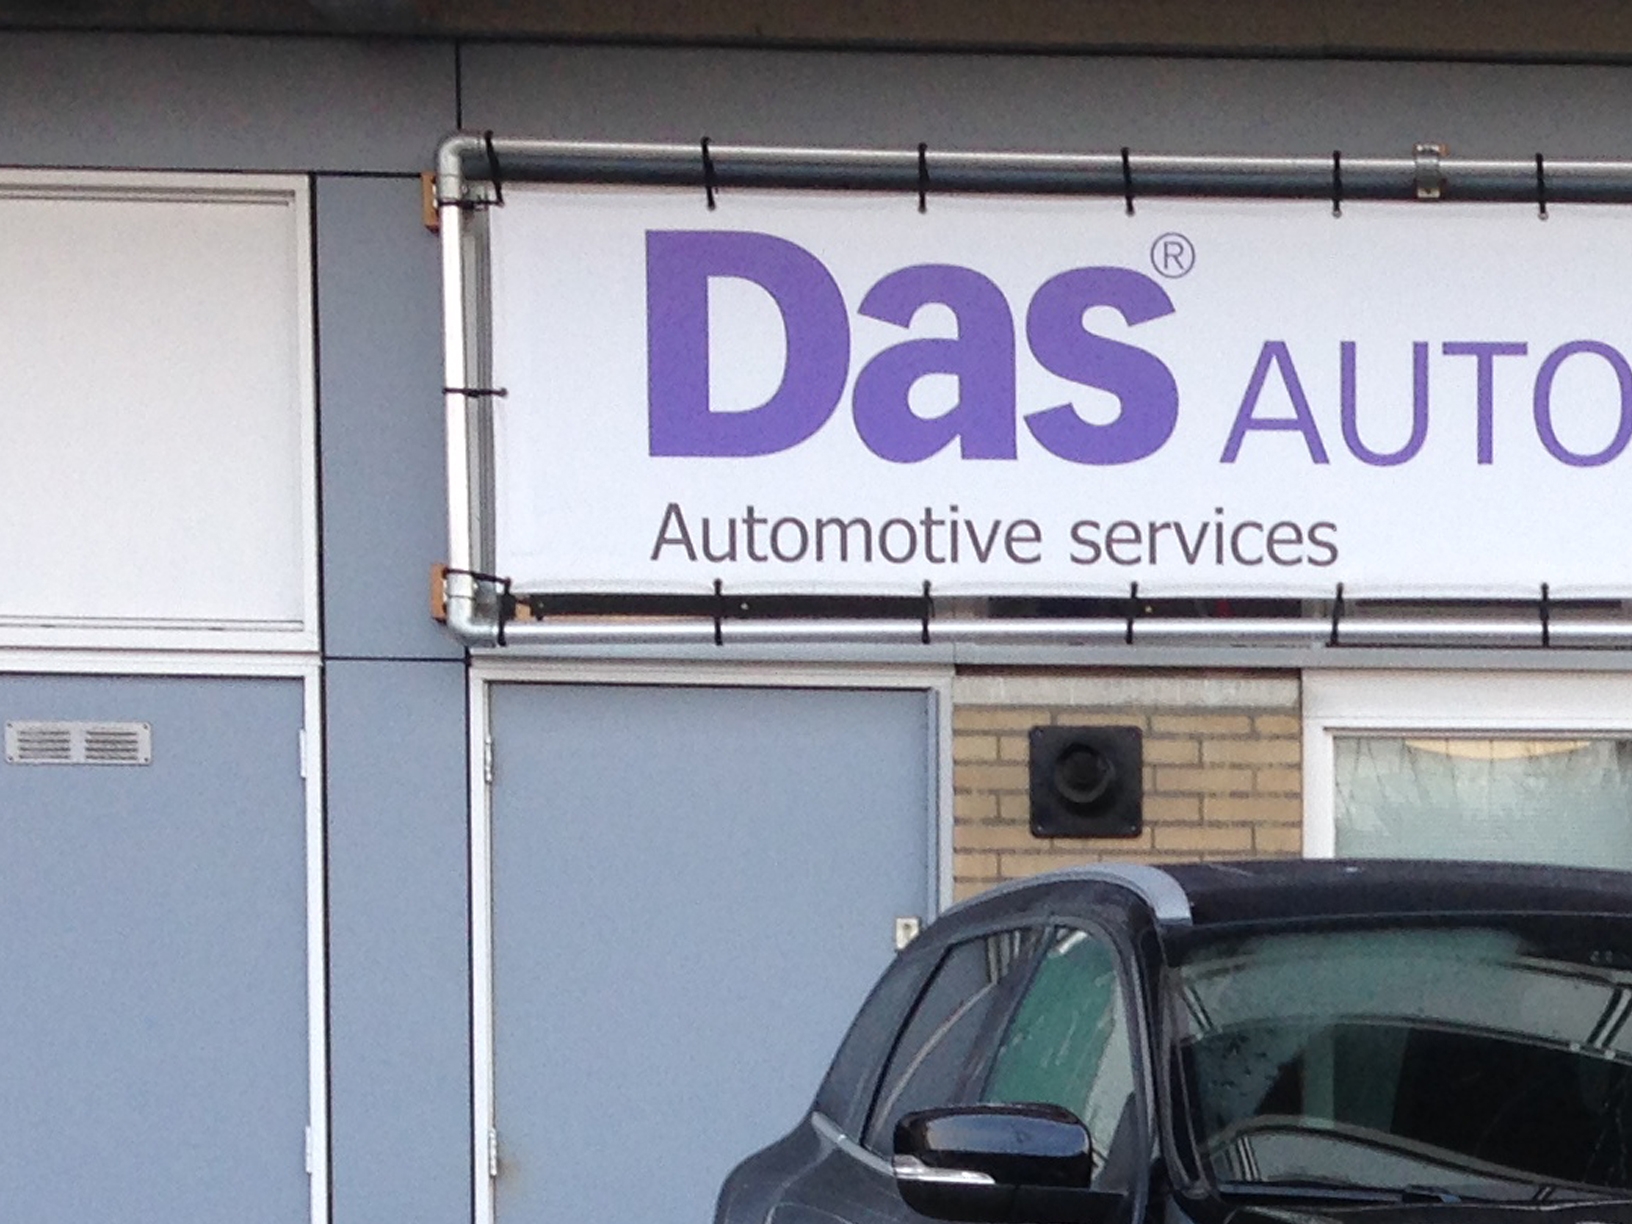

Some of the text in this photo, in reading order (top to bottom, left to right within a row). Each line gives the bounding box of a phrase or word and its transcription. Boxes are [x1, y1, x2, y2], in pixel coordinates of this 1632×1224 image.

[644, 228, 1180, 466] Das
[650, 502, 1339, 568] Automotive services
